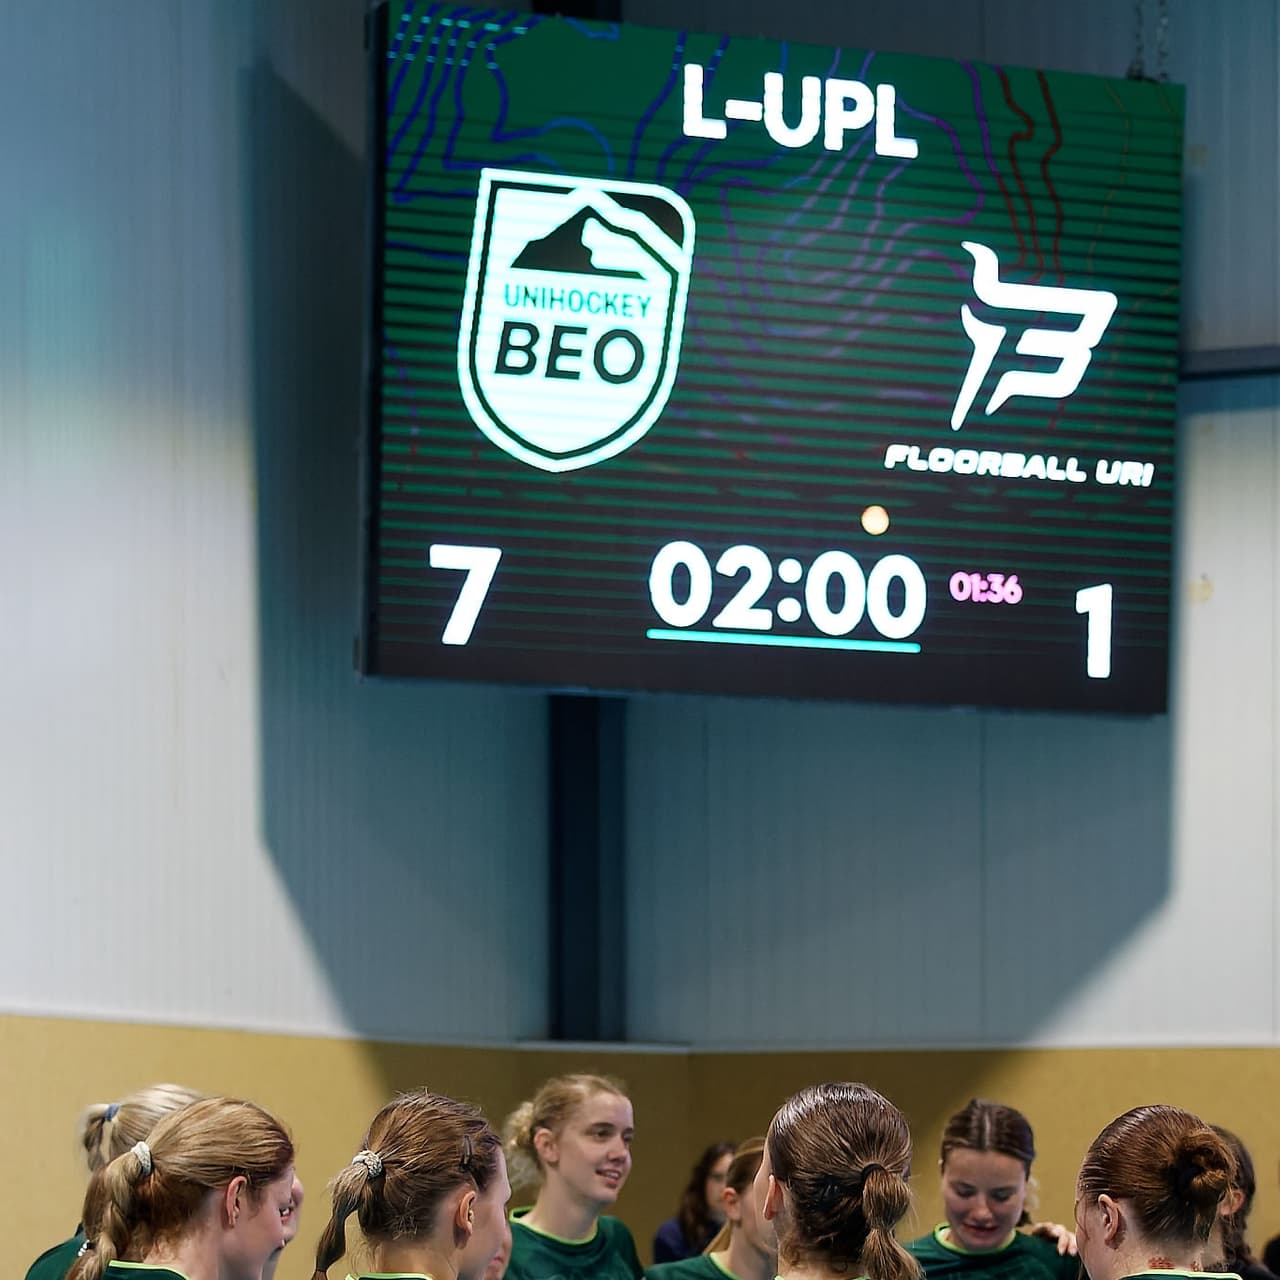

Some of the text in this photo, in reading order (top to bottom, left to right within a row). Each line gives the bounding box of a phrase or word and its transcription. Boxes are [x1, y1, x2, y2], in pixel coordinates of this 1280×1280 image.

[683, 63, 918, 158] L-UPL
[503, 283, 651, 318] UNIHOCKEY
[494, 321, 644, 385] BEO
[885, 444, 1155, 487] FLOORBALL URI
[429, 544, 502, 646] 7
[649, 541, 926, 640] 02:00
[949, 571, 1023, 605] 01:36
[1075, 584, 1113, 679] 1
